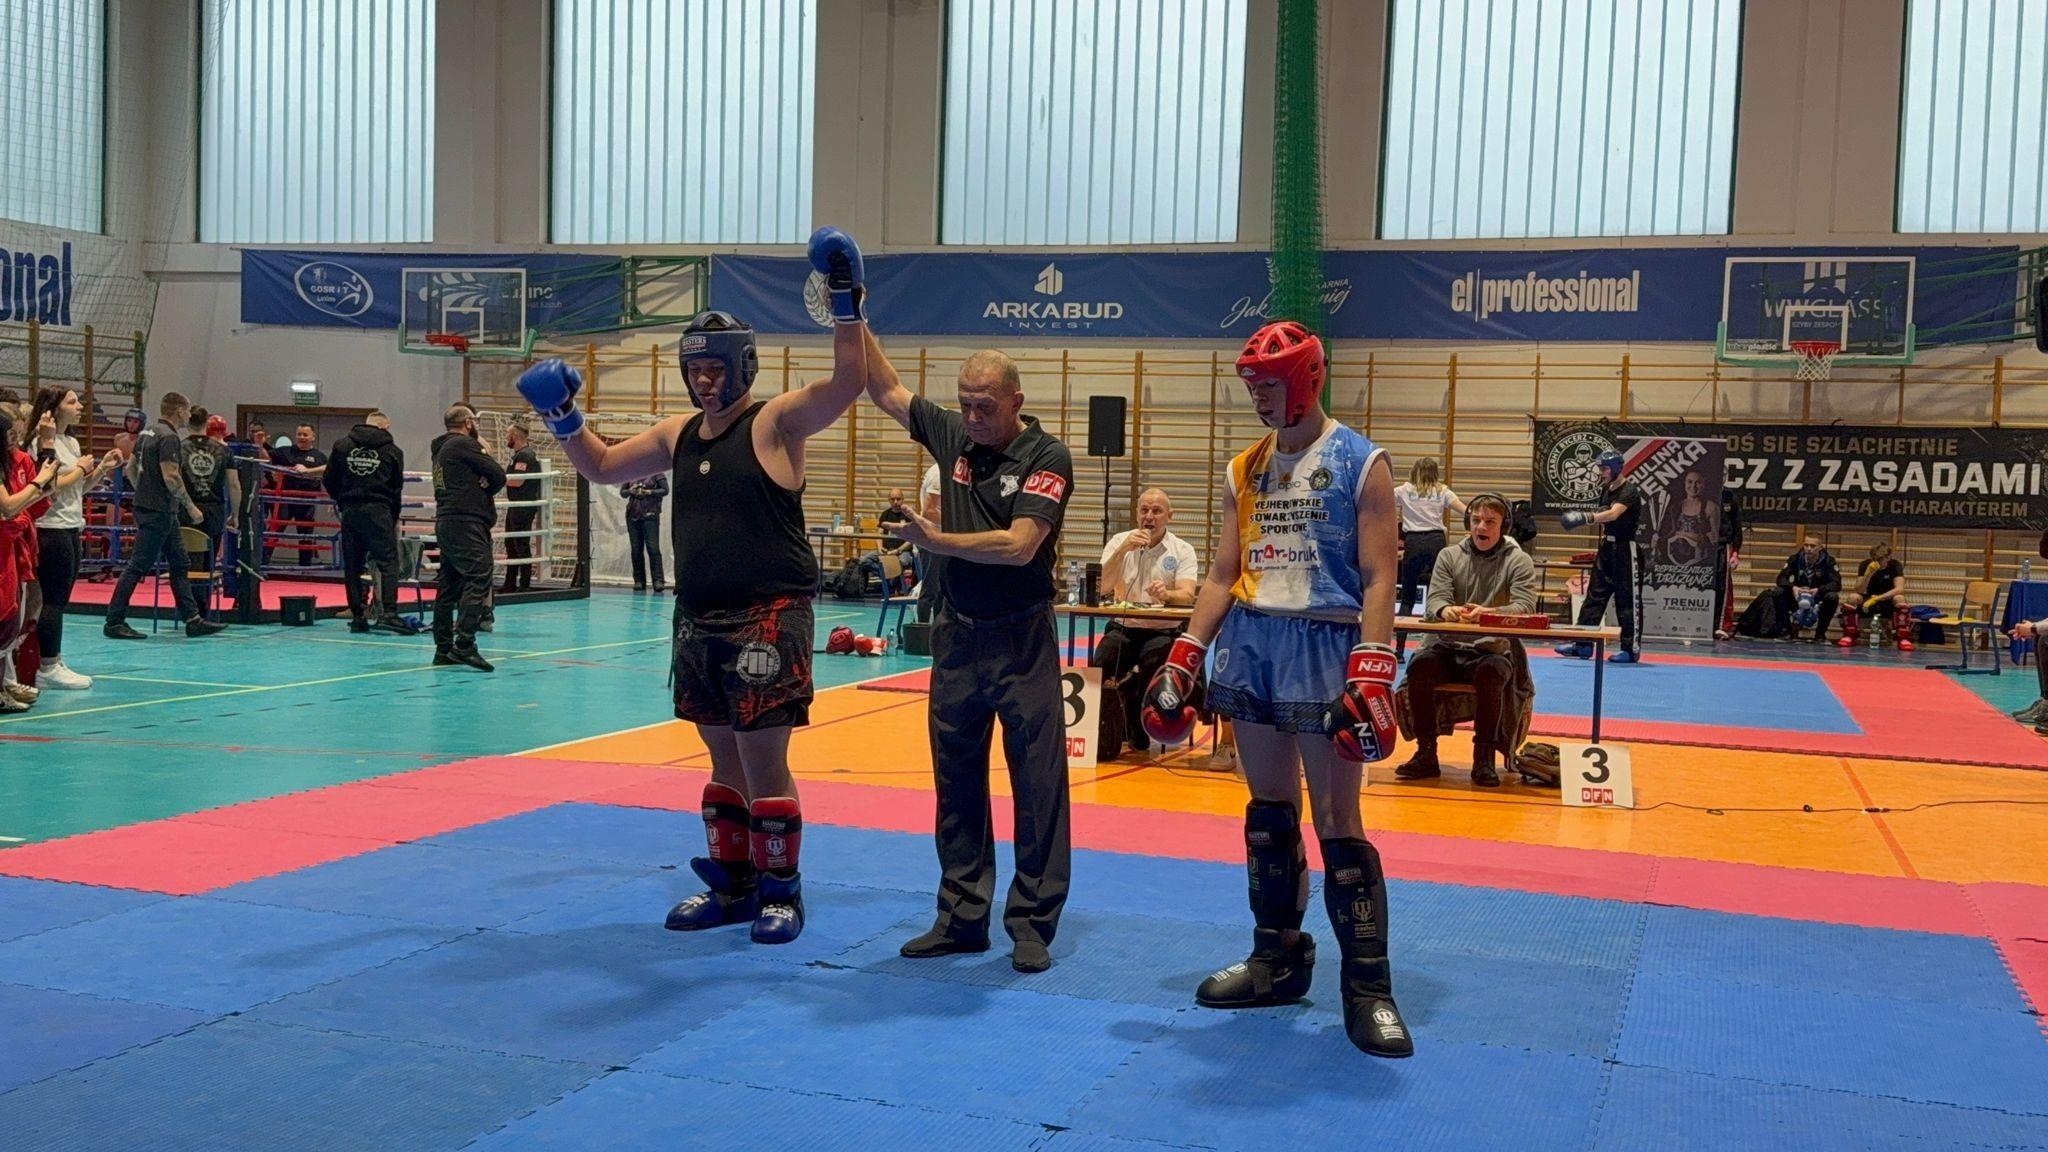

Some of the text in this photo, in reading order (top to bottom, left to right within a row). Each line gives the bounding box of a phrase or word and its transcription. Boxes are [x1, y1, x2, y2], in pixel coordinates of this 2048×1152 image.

[982, 302, 1124, 319] ARKABUD
[1559, 435, 1587, 449] RYCERZ
[1763, 435, 1798, 455] SIĘ
[1807, 436, 1958, 456] SZLACHETNIE
[1626, 440, 1681, 484] AULINA
[1638, 441, 1708, 498] ENKA
[1782, 459, 1805, 490] Z
[1818, 459, 2041, 496] ZASADAMI
[1742, 496, 2028, 517] LUDZI Z PASJĄ I CHARAKTEREM
[1664, 598, 1710, 608] TRENUJ
[1357, 661, 1393, 674] KFN
[1354, 722, 1377, 761] KFN
[1582, 747, 1610, 784] 3
[1582, 789, 1613, 803] DFN
